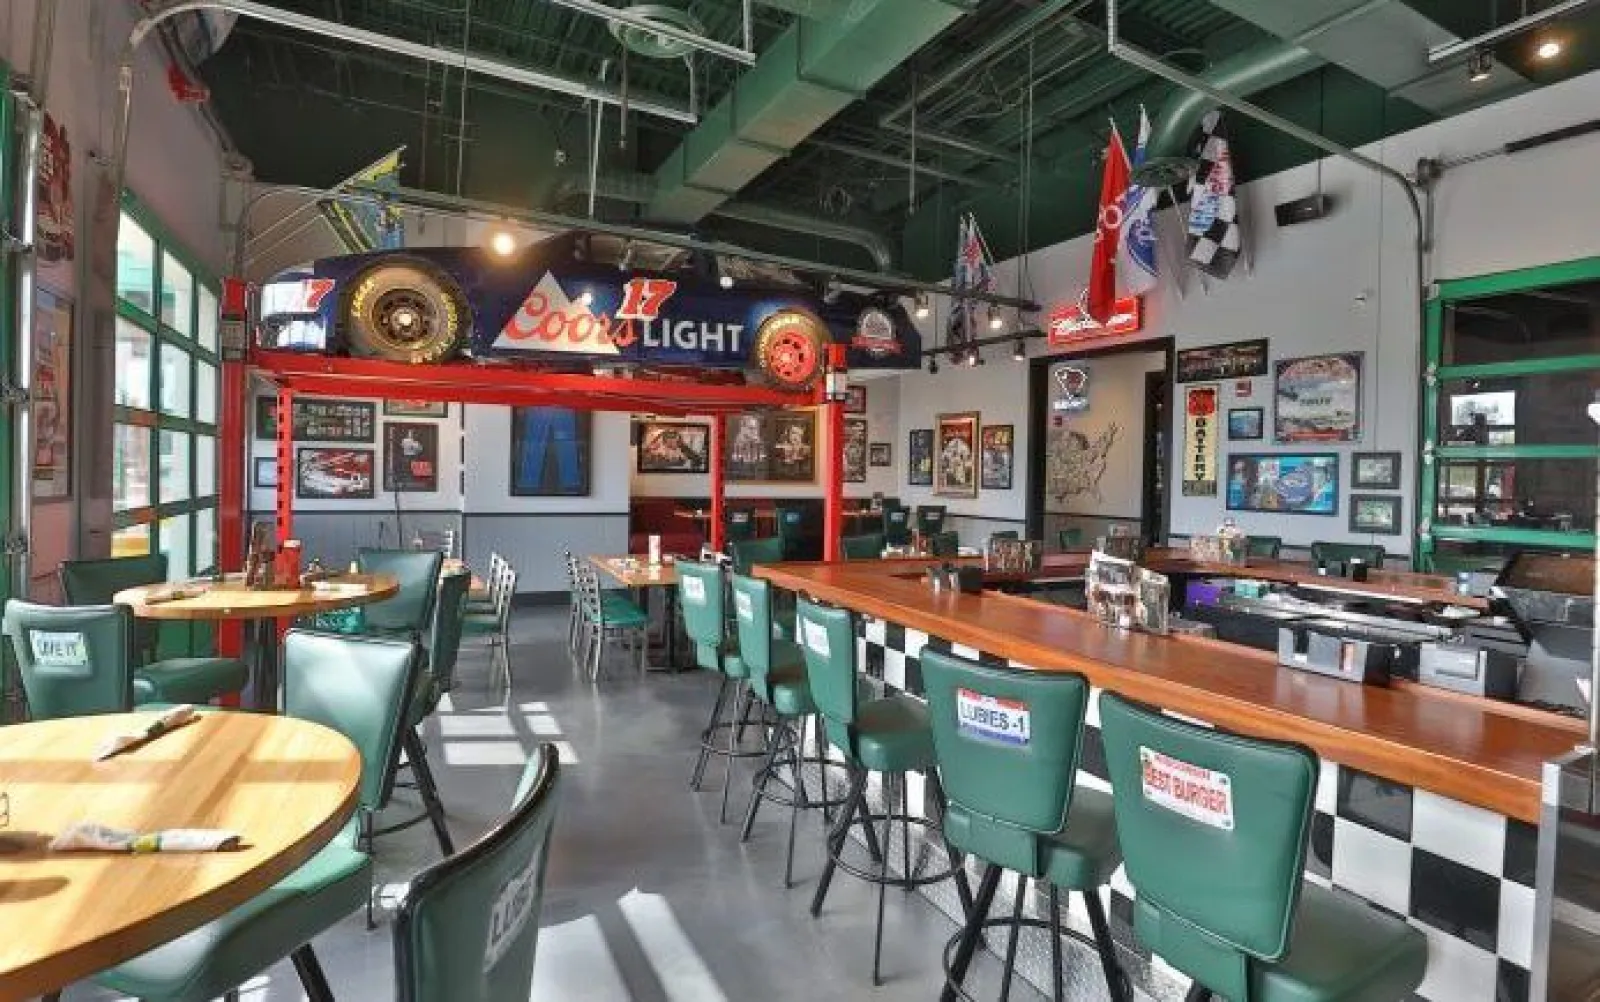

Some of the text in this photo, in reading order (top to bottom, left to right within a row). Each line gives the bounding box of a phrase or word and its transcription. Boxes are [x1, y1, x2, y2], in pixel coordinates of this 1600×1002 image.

[505, 292, 638, 347] Coors
[642, 317, 744, 352] LIGHT
[614, 277, 678, 321] 17
[1193, 418, 1207, 482] BATTERY
[1144, 763, 1171, 795] BEST
[1172, 776, 1228, 816] BURGER
